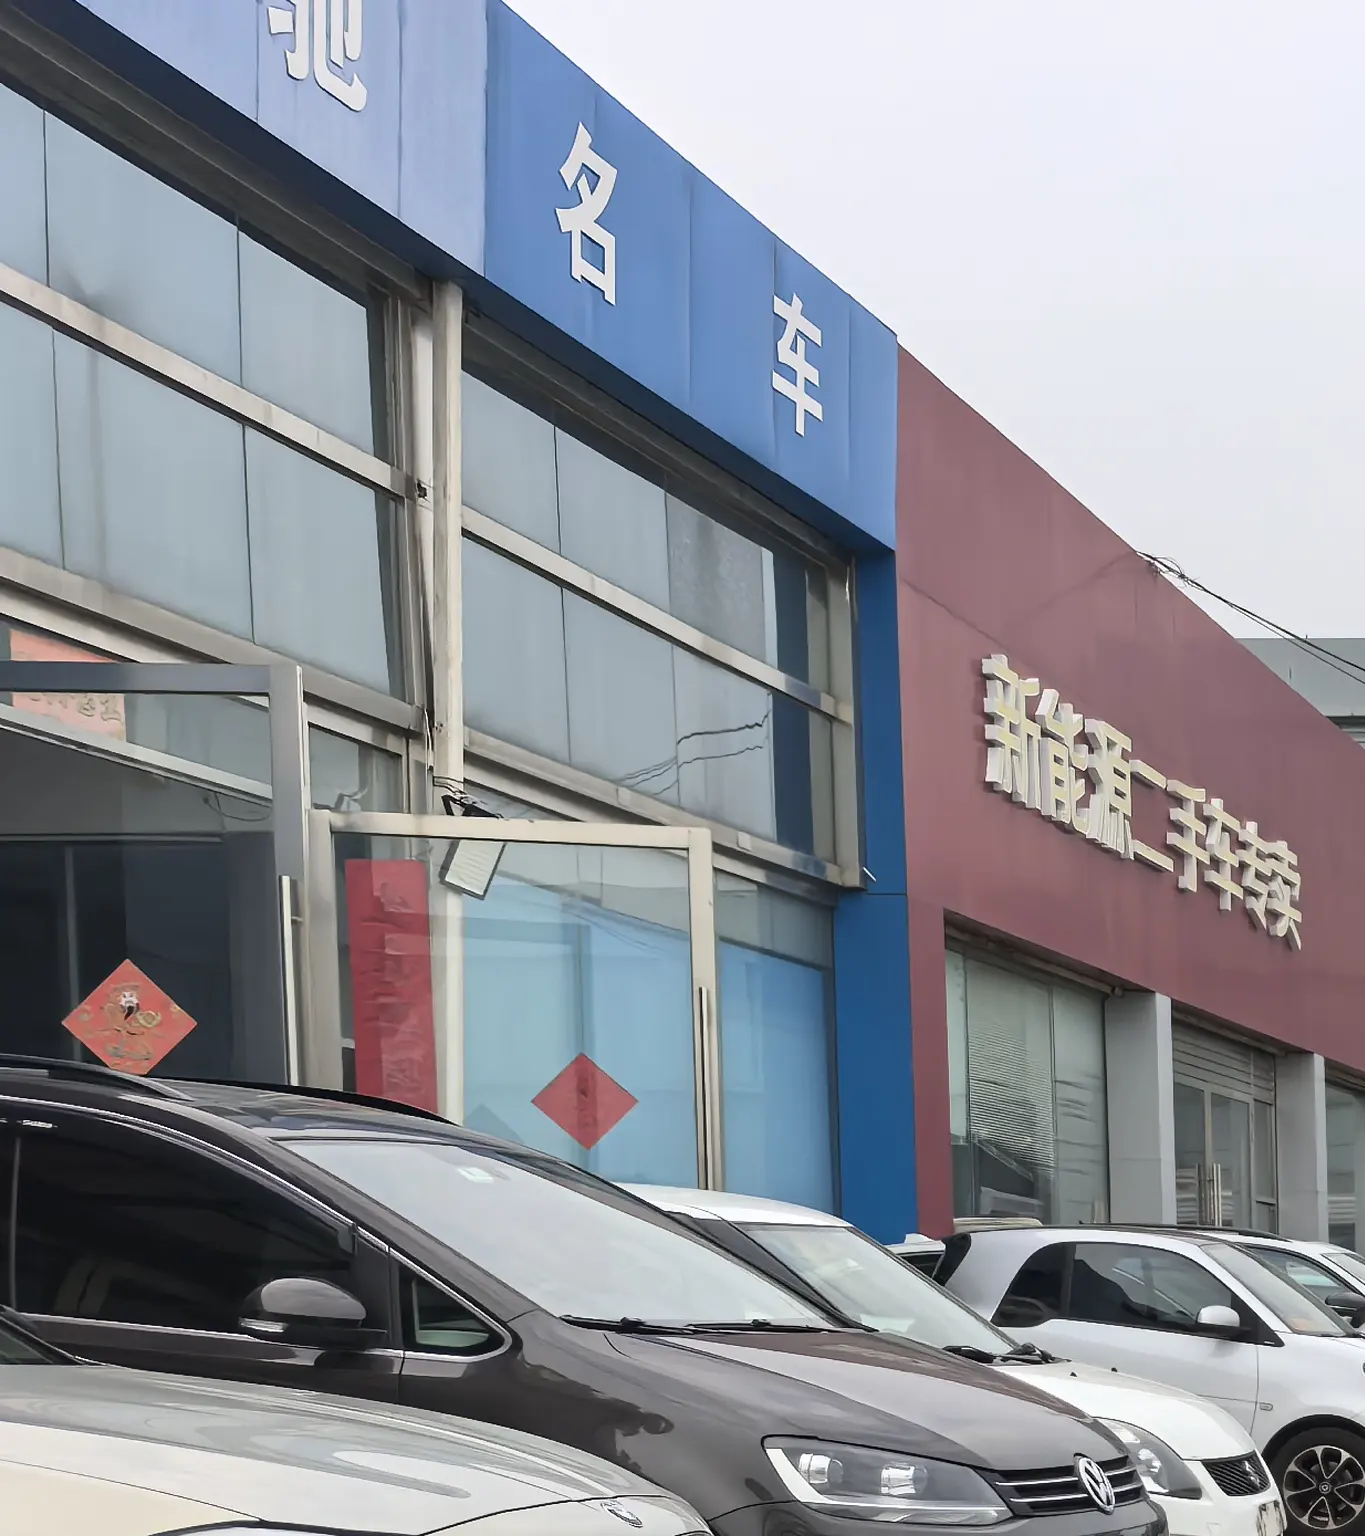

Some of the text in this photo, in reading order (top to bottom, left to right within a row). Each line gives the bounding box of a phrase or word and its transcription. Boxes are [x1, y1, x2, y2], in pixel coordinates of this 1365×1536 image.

[981, 654, 1302, 950] 新能源二手车专卖
